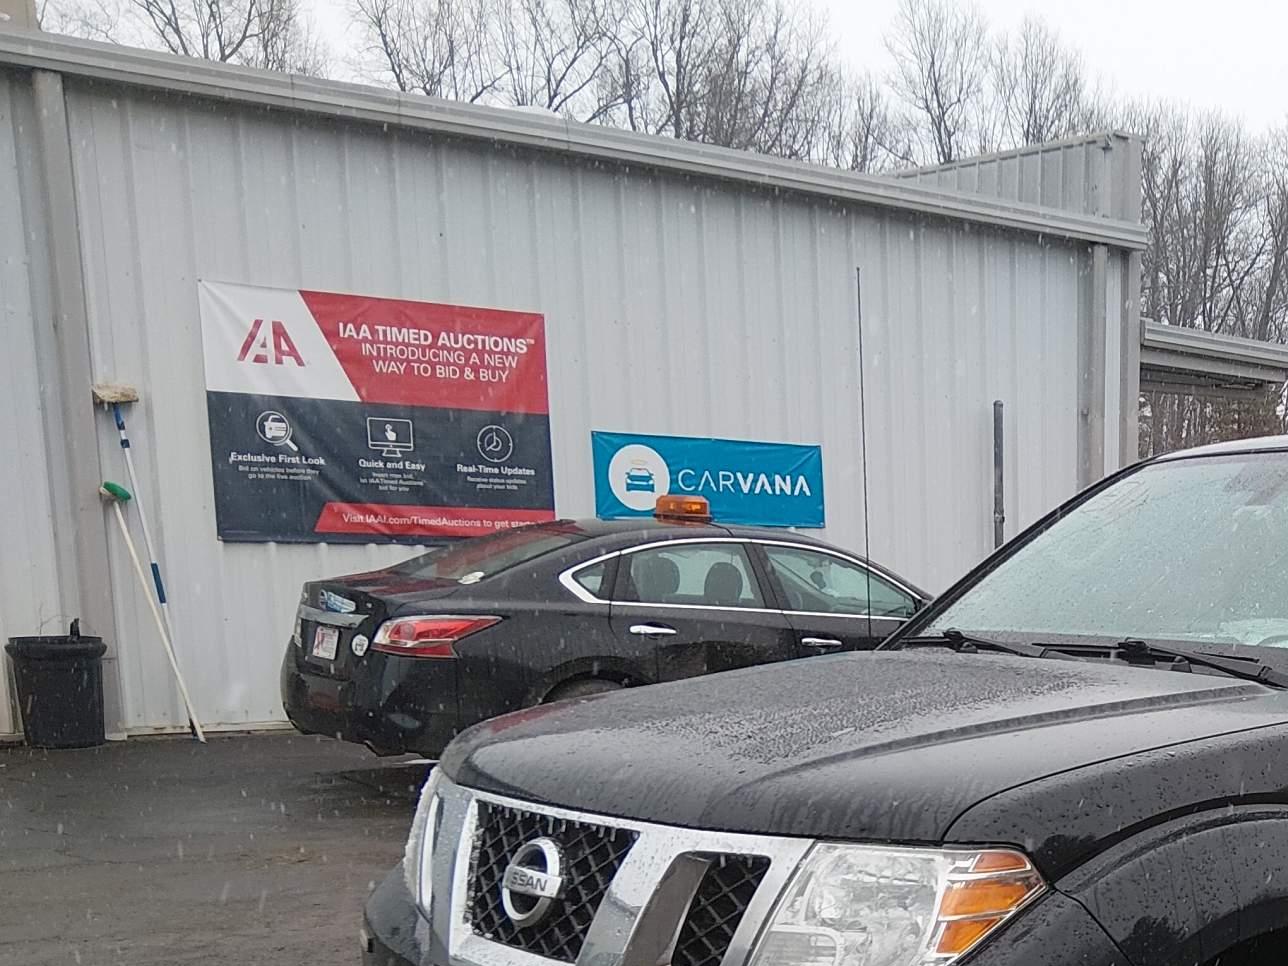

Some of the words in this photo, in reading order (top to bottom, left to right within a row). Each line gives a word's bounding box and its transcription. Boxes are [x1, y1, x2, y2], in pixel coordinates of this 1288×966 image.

[338, 322, 372, 340] IAA
[374, 325, 432, 345] TIMED
[361, 342, 465, 365] INTRODUCING
[469, 351, 481, 364] A
[483, 352, 519, 368] NEW
[372, 359, 406, 375] WAY
[411, 361, 432, 376] TO
[436, 364, 459, 379] BID
[463, 366, 476, 381] &
[480, 367, 510, 383] BUY
[230, 452, 276, 463] Exclusive
[278, 454, 301, 464] First
[302, 456, 327, 465] Look
[358, 459, 385, 469] Quick
[386, 461, 404, 469] and
[405, 461, 426, 472] Easy
[456, 464, 499, 474] Real-Time
[501, 466, 535, 476] Updates
[678, 469, 811, 497] CARVANA
[343, 513, 363, 523] Visit
[483, 519, 492, 528] to
[494, 520, 509, 529] get
